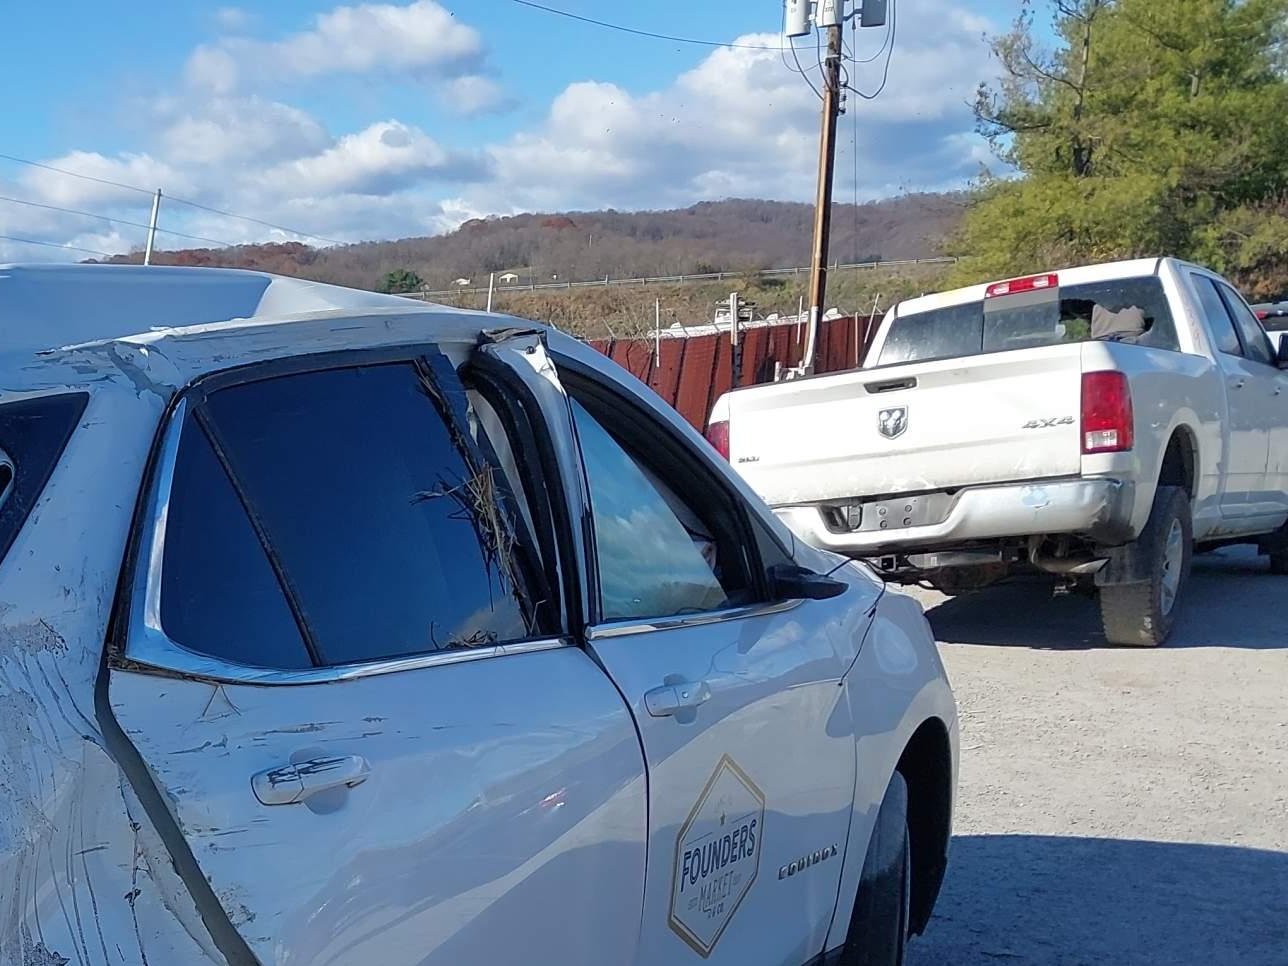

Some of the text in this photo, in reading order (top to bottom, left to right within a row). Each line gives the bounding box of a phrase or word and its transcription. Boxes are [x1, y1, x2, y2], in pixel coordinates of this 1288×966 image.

[680, 818, 758, 893] FOUNDERS
[778, 843, 840, 881] EQUINOX
[697, 870, 734, 912] MARKET
